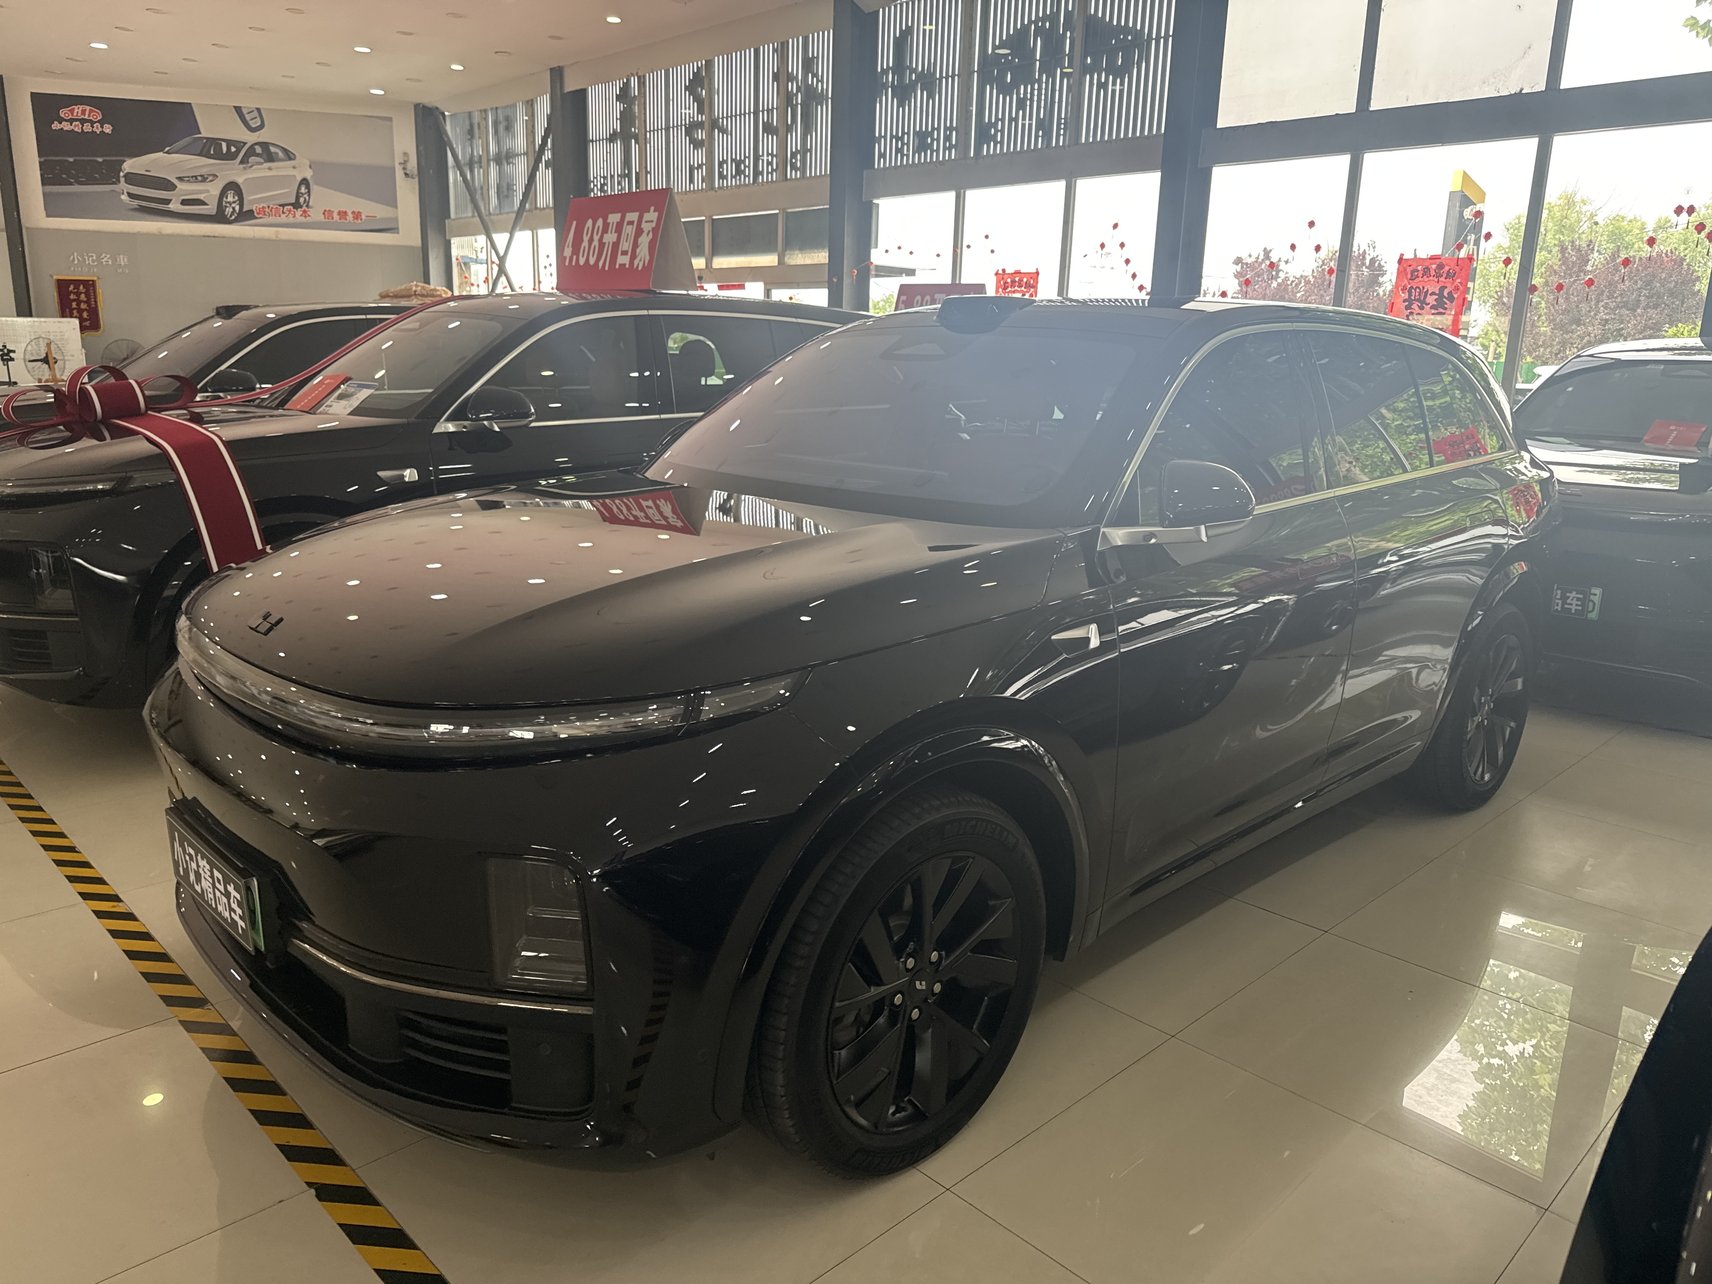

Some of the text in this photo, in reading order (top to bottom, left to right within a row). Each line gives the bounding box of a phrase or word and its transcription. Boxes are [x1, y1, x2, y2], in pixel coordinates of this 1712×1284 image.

[254, 205, 378, 222] 诚信为本 信誉第一
[563, 206, 658, 271] 4.88开回家
[173, 831, 246, 934] 小记精品车
